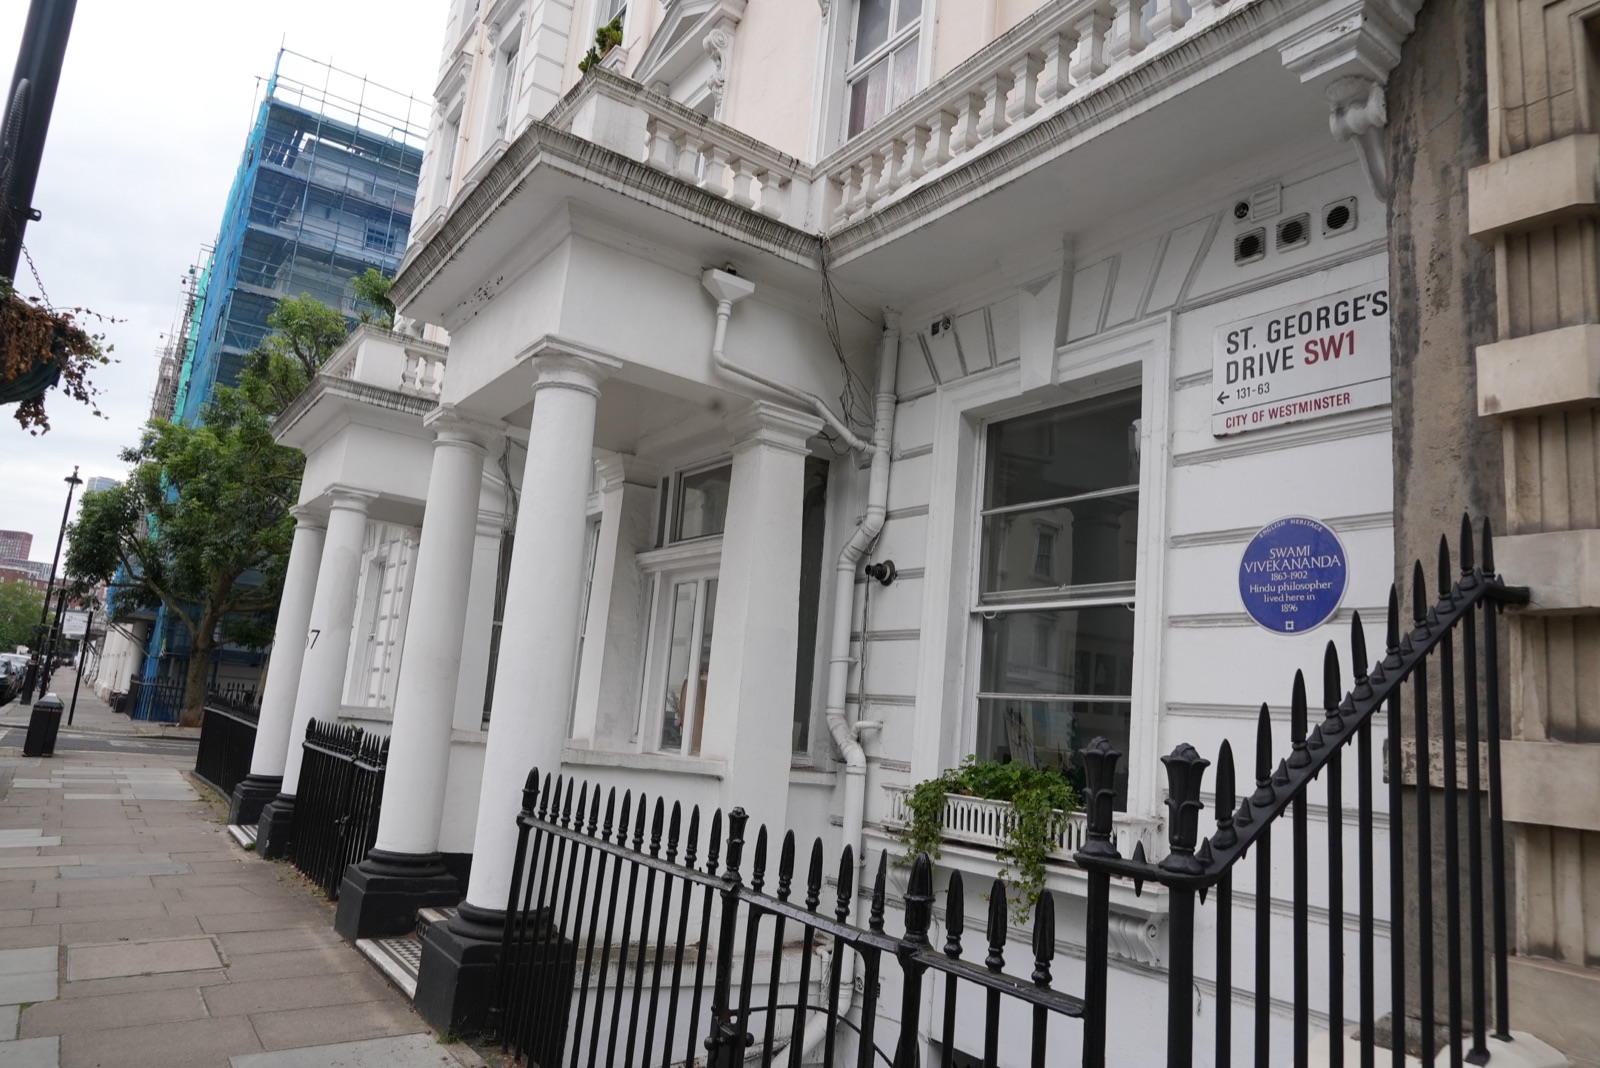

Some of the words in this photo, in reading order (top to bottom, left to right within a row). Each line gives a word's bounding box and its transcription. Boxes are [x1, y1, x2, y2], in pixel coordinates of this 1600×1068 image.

[1226, 326, 1257, 355] ST.
[1267, 290, 1388, 344] GEORGE'S
[1226, 345, 1294, 385] DRIVE
[1304, 330, 1355, 365] SW1
[1236, 382, 1270, 400] 131-63
[1225, 414, 1248, 429] CITY
[1252, 410, 1265, 423] OF
[1268, 392, 1351, 420] WESTMINSTER
[1259, 520, 1286, 539] ENGLISH
[1290, 519, 1323, 532] HERITAGE
[1269, 545, 1310, 559] SWAMI
[1244, 555, 1341, 573] VIVEKANANDA
[1271, 570, 1308, 581] 1863-1902
[1249, 584, 1276, 593] Hindu
[1278, 580, 1333, 594] philosopher
[1264, 594, 1284, 603] lived
[1285, 593, 1305, 602] here
[1281, 604, 1298, 612] 1896
